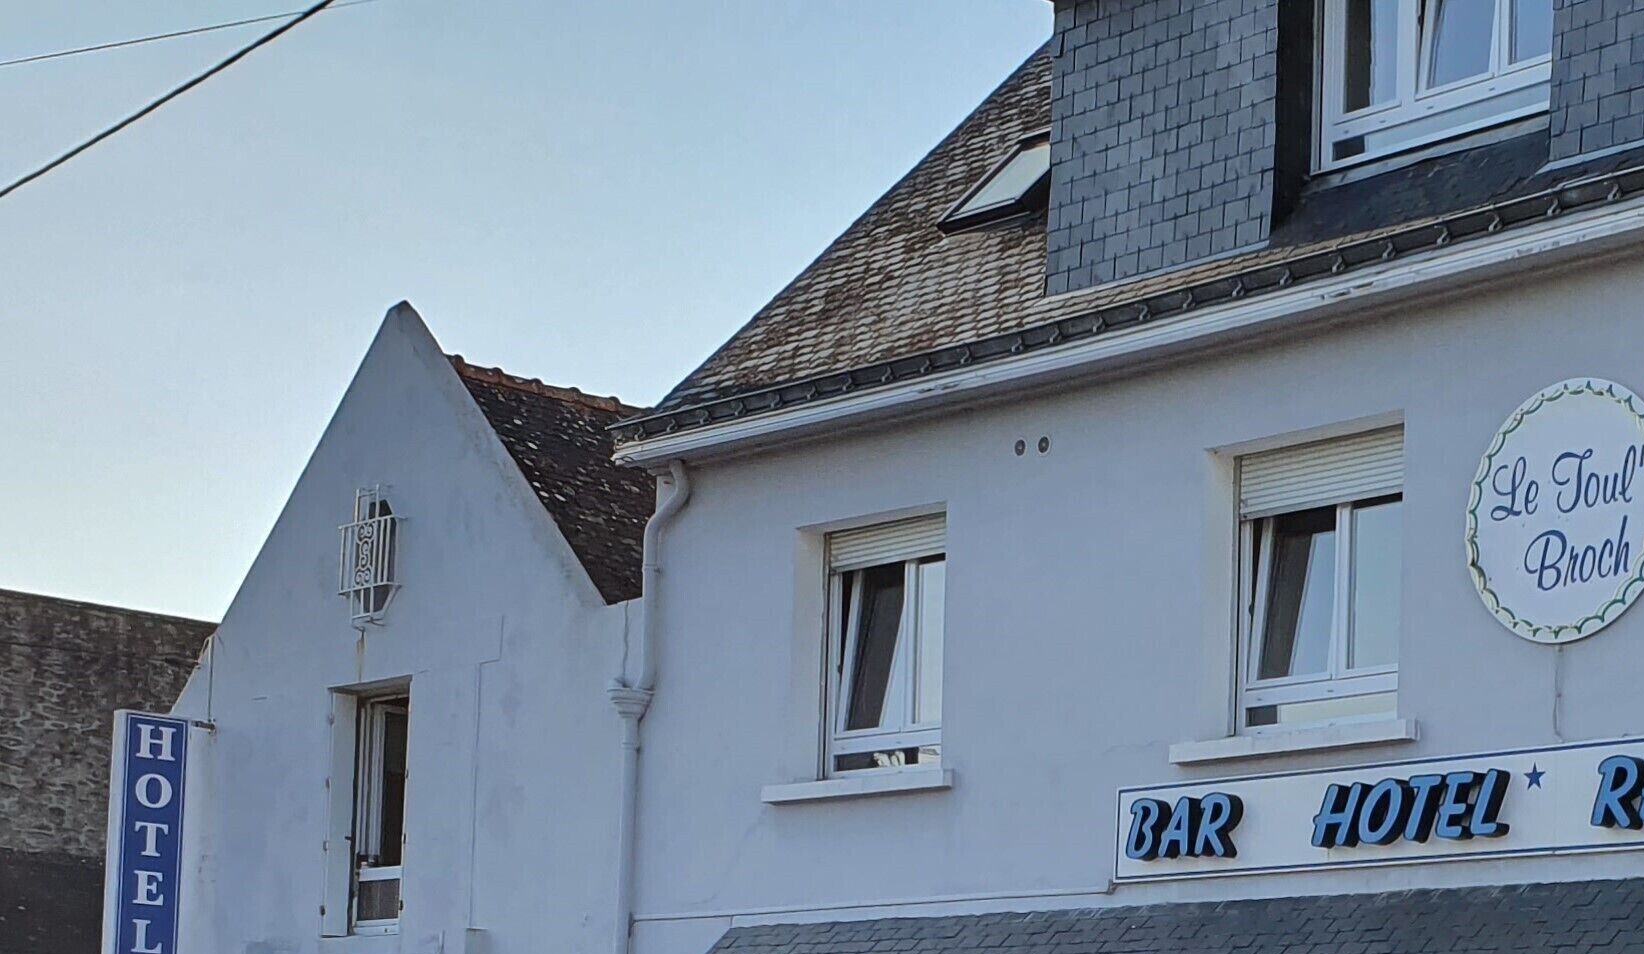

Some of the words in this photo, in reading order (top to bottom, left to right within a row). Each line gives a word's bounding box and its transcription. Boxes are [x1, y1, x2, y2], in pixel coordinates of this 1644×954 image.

[1490, 456, 1540, 522] Le
[1523, 514, 1630, 591] Broch
[130, 723, 177, 954] HOTEL
[1125, 792, 1244, 861] BAR
[1311, 768, 1510, 848] HOTEL
